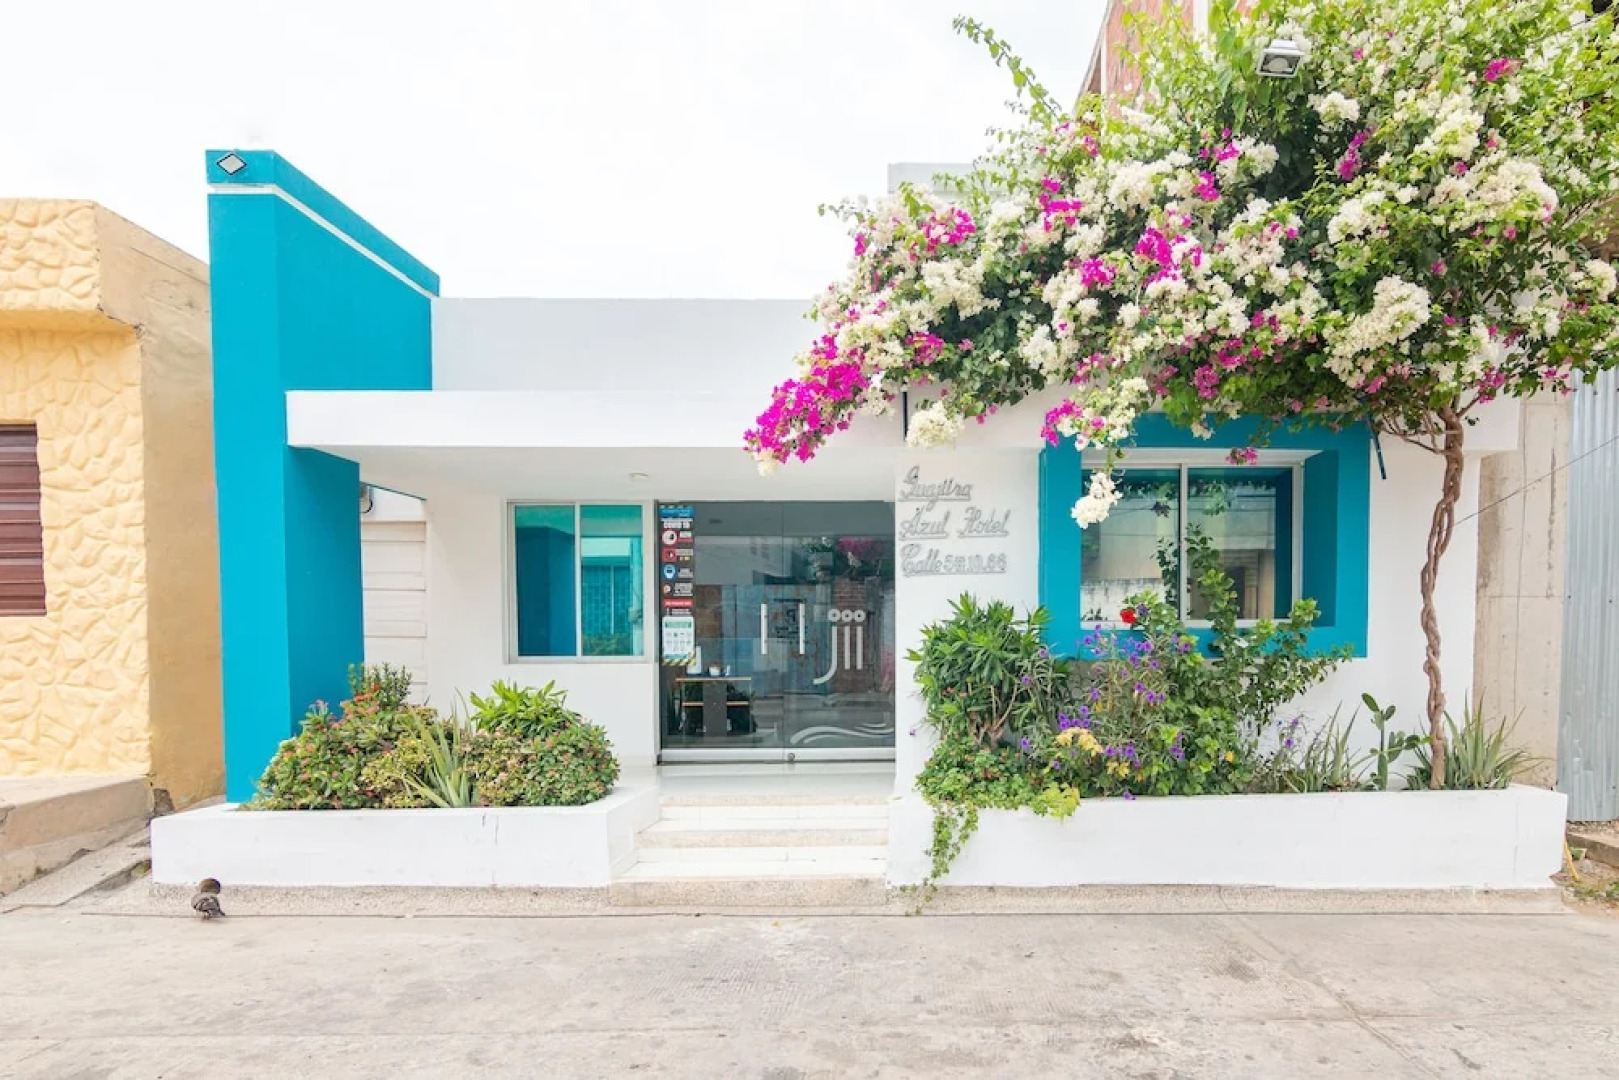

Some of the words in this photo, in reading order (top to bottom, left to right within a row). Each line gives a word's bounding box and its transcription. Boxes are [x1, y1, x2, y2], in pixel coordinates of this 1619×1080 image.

[899, 506, 951, 540] Azul
[957, 506, 1011, 538] Hotel
[899, 543, 943, 577] Calle
